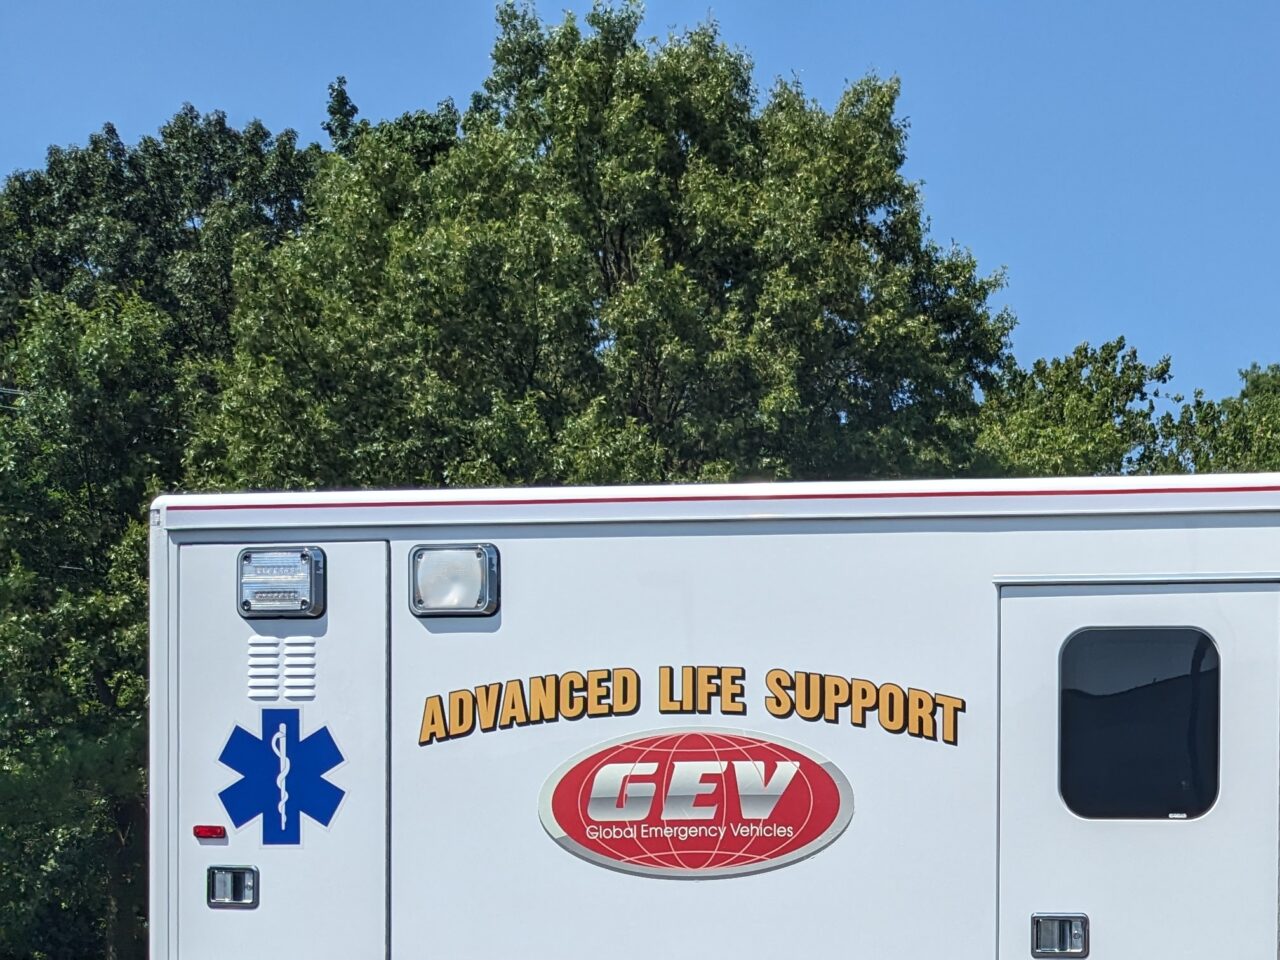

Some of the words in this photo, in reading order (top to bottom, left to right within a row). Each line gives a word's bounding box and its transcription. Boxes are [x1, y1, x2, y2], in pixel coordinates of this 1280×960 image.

[418, 667, 641, 747] ADVANCED
[658, 666, 747, 715] LIFE
[765, 668, 966, 746] SUPPORT
[587, 761, 800, 822] GEV
[586, 824, 637, 840] Global
[641, 823, 727, 841] Emergency
[730, 823, 793, 838] Vehicles
